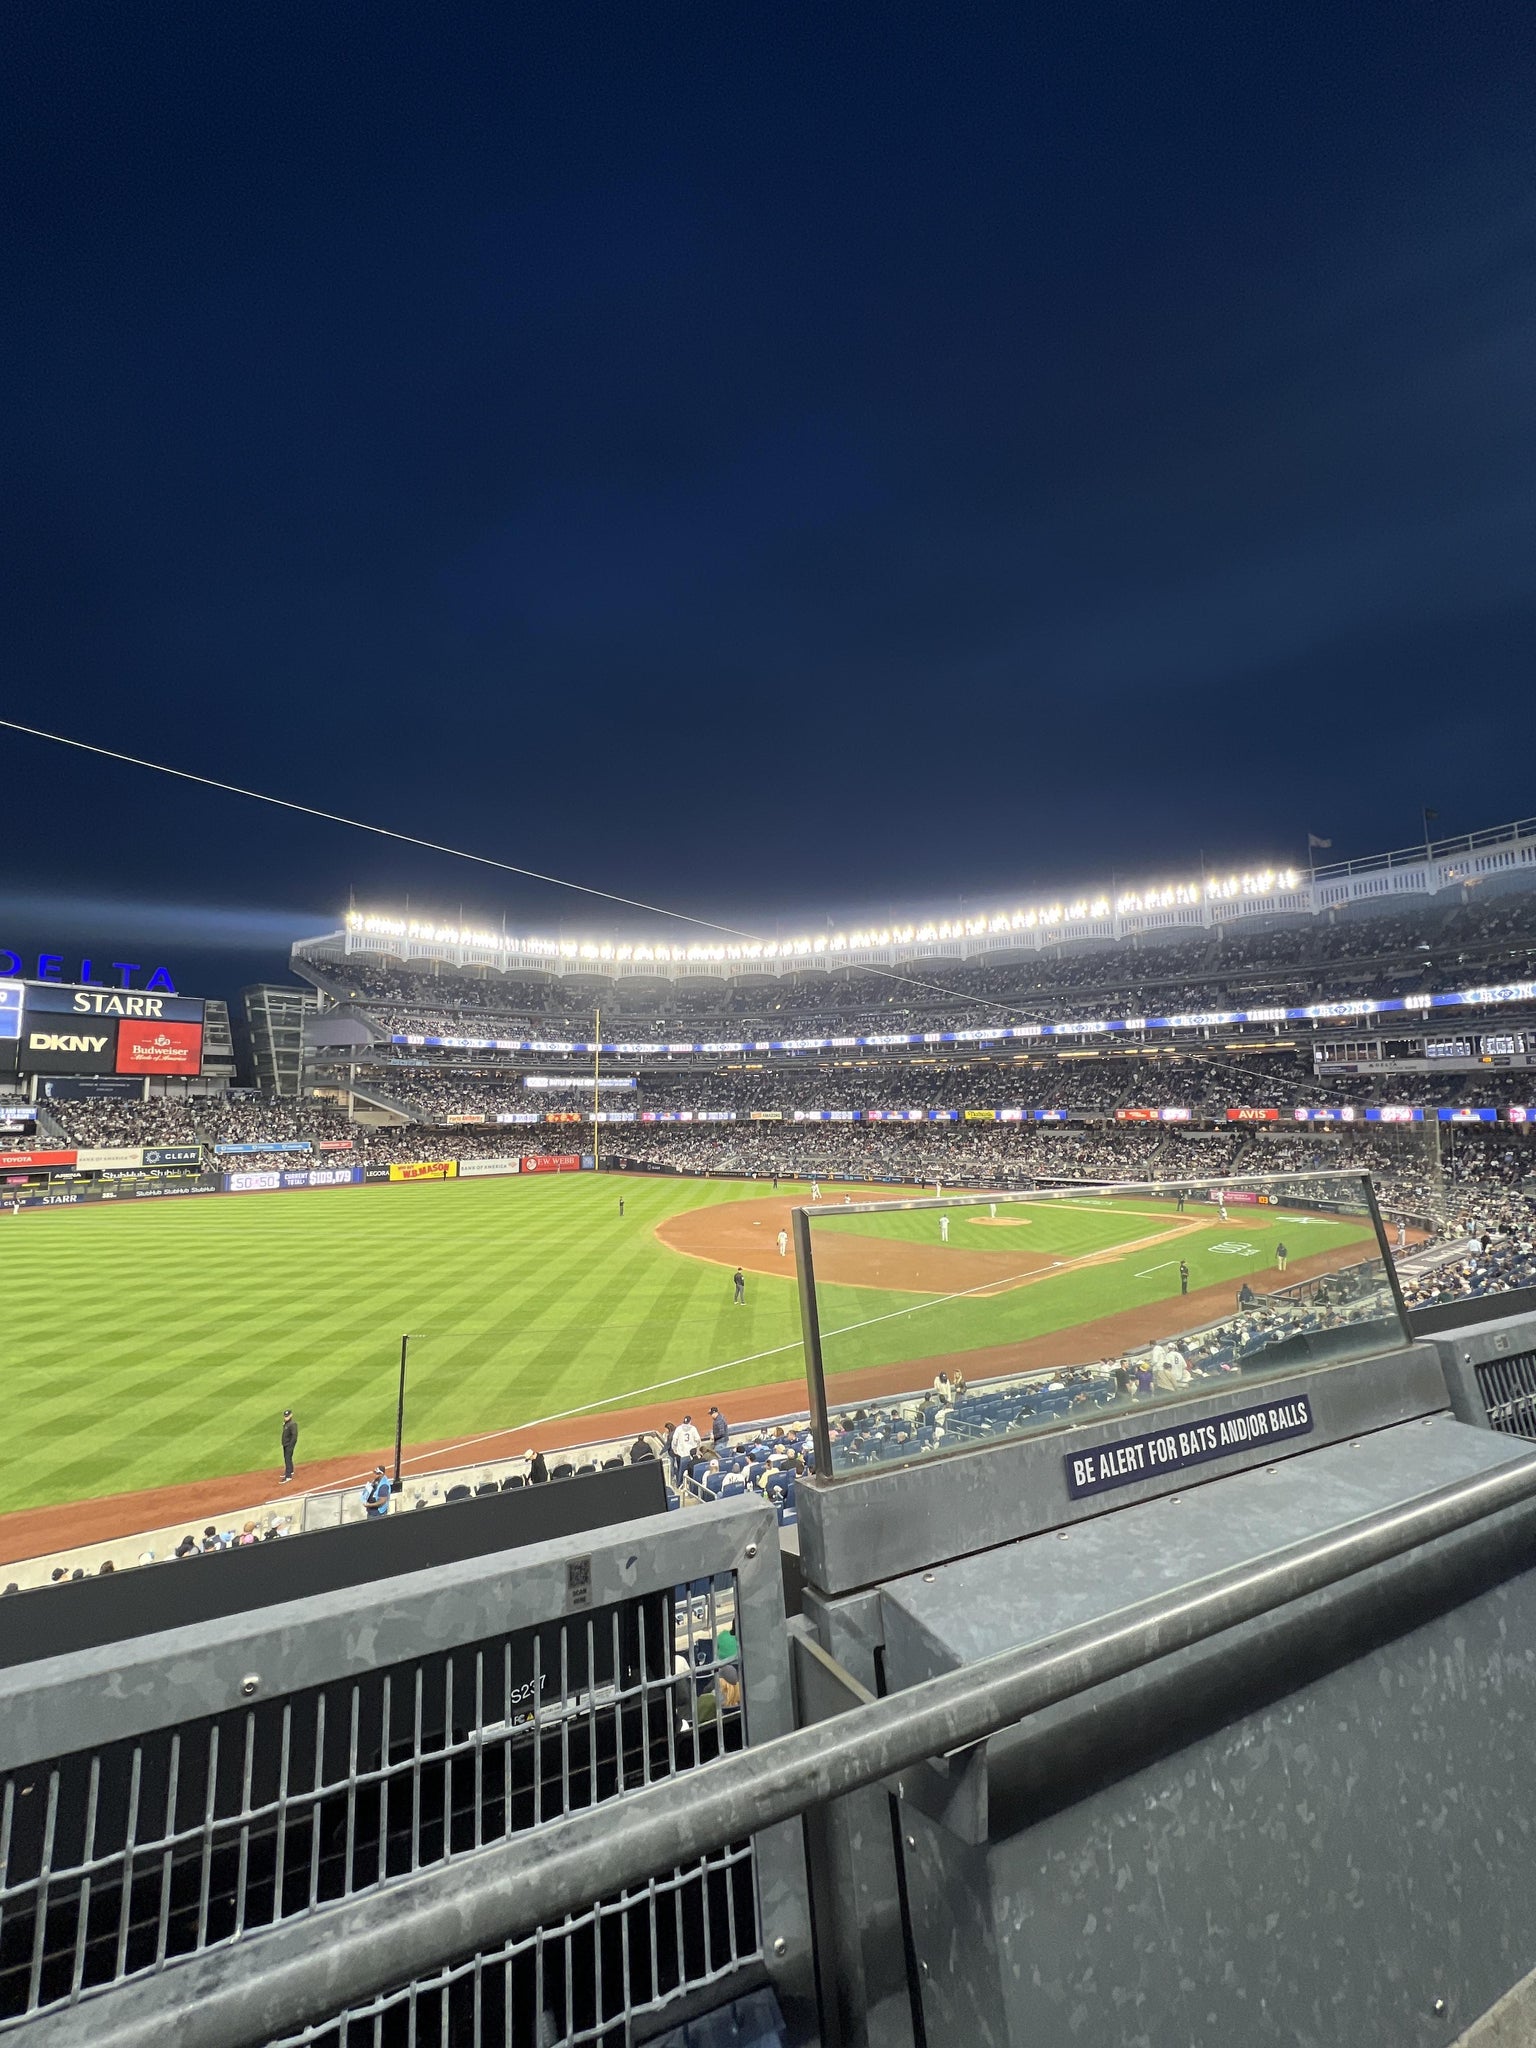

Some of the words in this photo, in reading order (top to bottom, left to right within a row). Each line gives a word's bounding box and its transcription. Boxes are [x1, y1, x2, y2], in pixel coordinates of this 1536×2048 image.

[0, 949, 176, 993] DELTA
[72, 992, 163, 1017] STARR
[29, 1033, 108, 1052] DKNY
[132, 1045, 189, 1055] Budweiser
[1238, 1110, 1266, 1119] AVIS
[165, 1152, 196, 1160] CLEAR
[150, 1169, 191, 1178] StubHub
[136, 1189, 162, 1197] StubHub
[163, 1187, 190, 1195] StubHub
[42, 1194, 78, 1204] STARR
[684, 1432, 690, 1442] 3
[1073, 1457, 1096, 1487] BE
[1100, 1443, 1144, 1480] ALERT
[1148, 1437, 1177, 1465] FOR
[1178, 1425, 1217, 1457] BATS
[1219, 1411, 1268, 1447] AND/OR
[1268, 1402, 1309, 1430] BALLS
